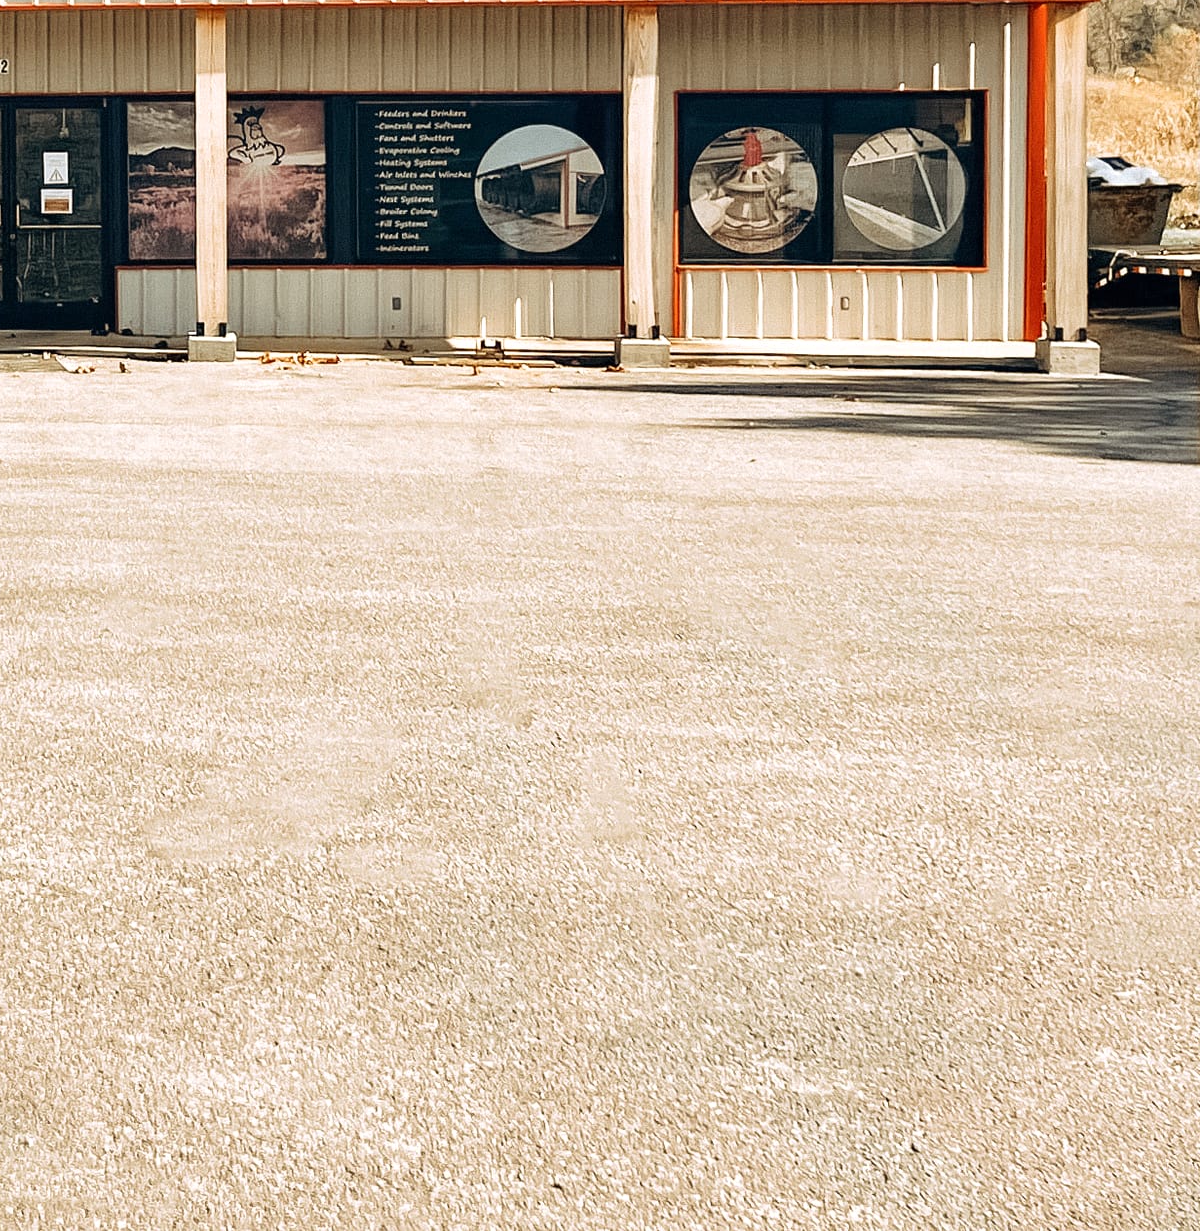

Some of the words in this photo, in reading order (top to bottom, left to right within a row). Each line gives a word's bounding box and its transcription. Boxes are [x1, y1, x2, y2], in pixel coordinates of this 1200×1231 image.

[412, 110, 429, 118] and
[430, 110, 467, 118] Drinkers
[415, 122, 432, 130] and
[434, 122, 472, 130] Software
[429, 147, 460, 156] Cooling
[414, 158, 447, 168] Systems
[400, 196, 434, 204] Systems
[394, 220, 428, 229] Systems
